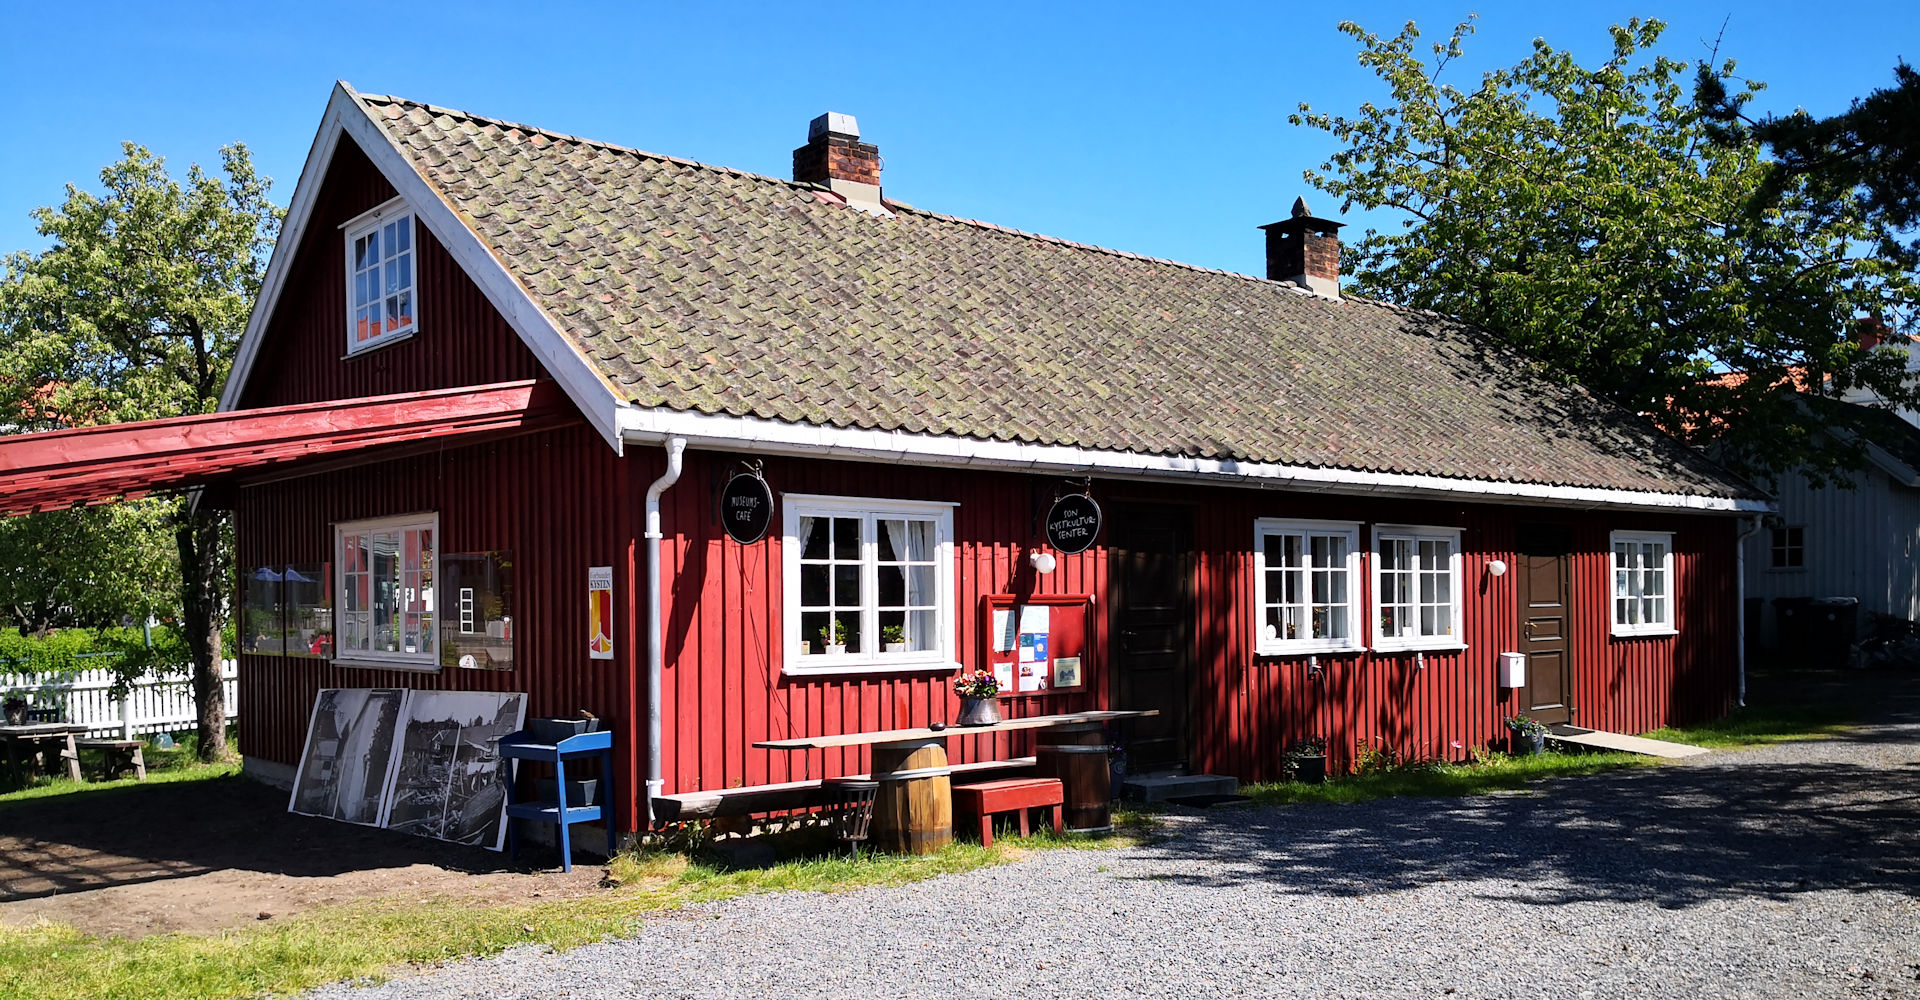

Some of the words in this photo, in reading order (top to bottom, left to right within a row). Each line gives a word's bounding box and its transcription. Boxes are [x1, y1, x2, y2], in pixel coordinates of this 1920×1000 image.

[1063, 508, 1079, 519] SON
[1058, 527, 1089, 540] SENTER
[590, 579, 611, 589] KYSTEN
